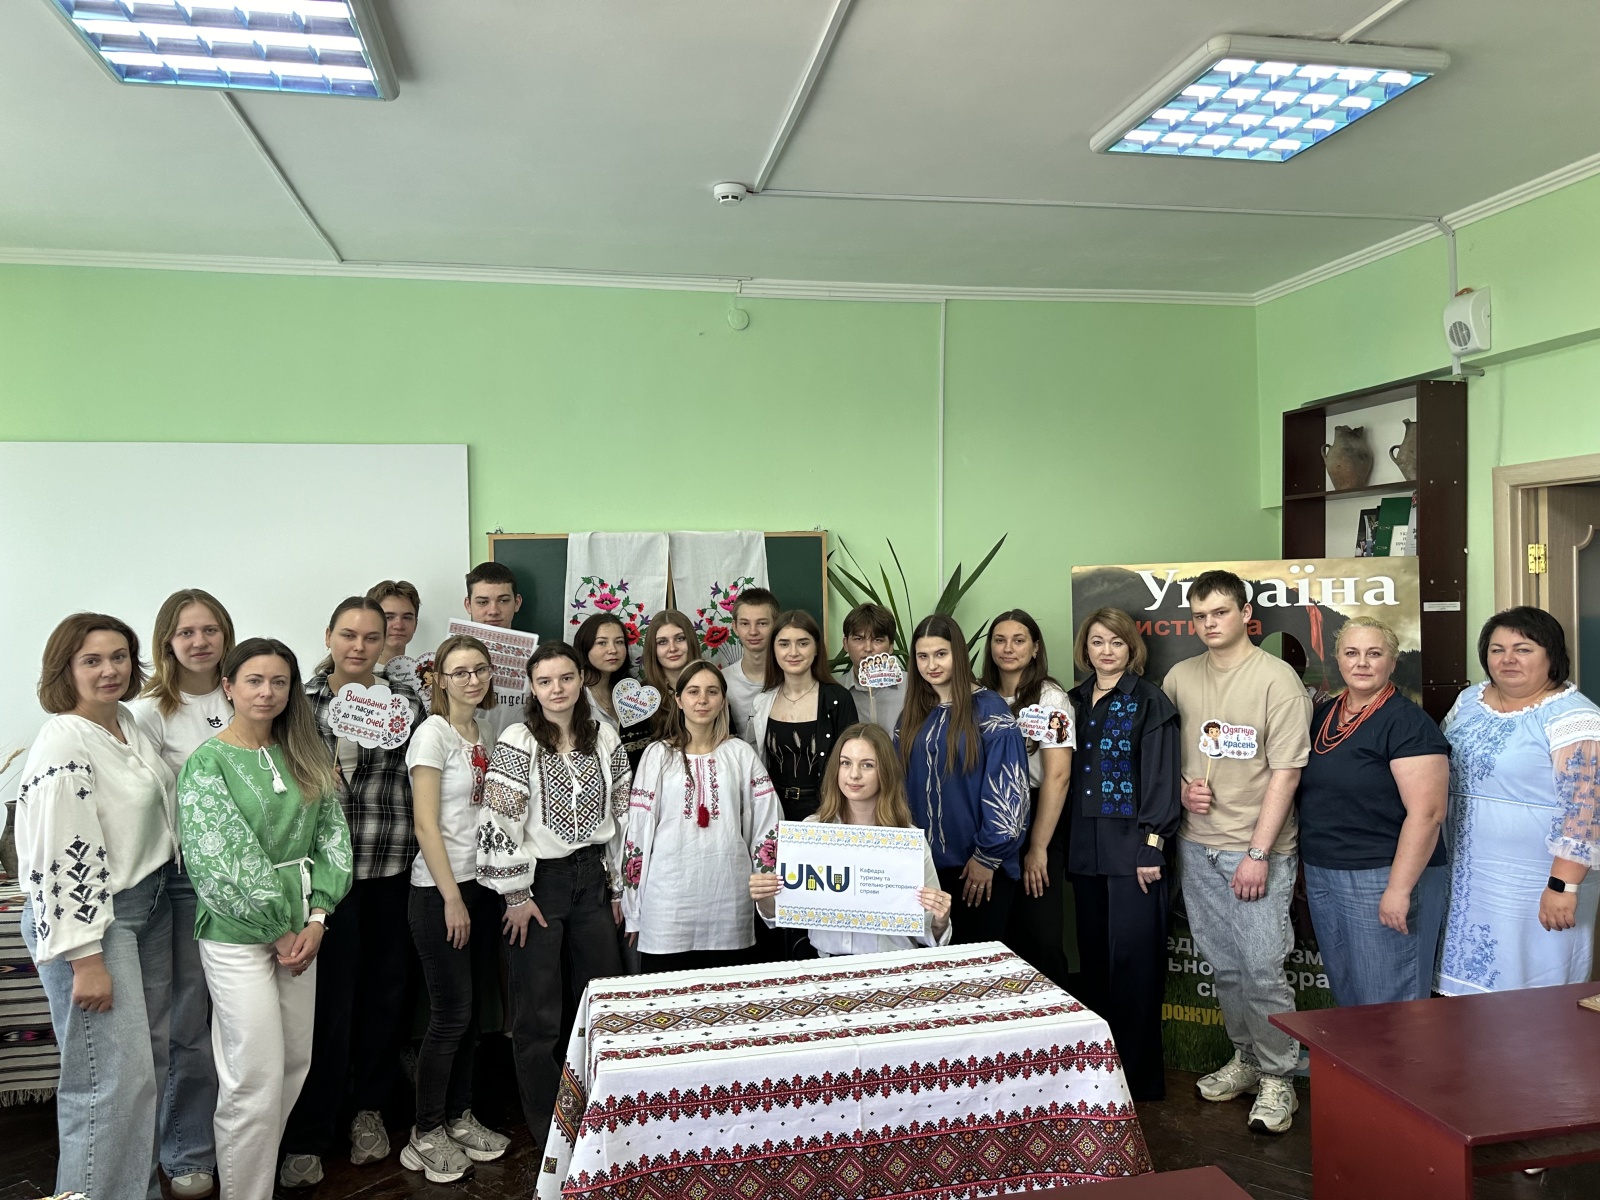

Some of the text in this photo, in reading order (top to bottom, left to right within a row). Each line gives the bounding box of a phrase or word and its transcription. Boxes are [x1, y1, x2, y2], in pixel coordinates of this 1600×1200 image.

[345, 689, 388, 711] Вишиванка
[623, 695, 648, 707] люблю
[355, 705, 375, 717] пасує
[1222, 724, 1255, 737] Одягнув
[1236, 734, 1241, 742] і
[1223, 740, 1256, 749] красень
[859, 867, 885, 875] Кафедра
